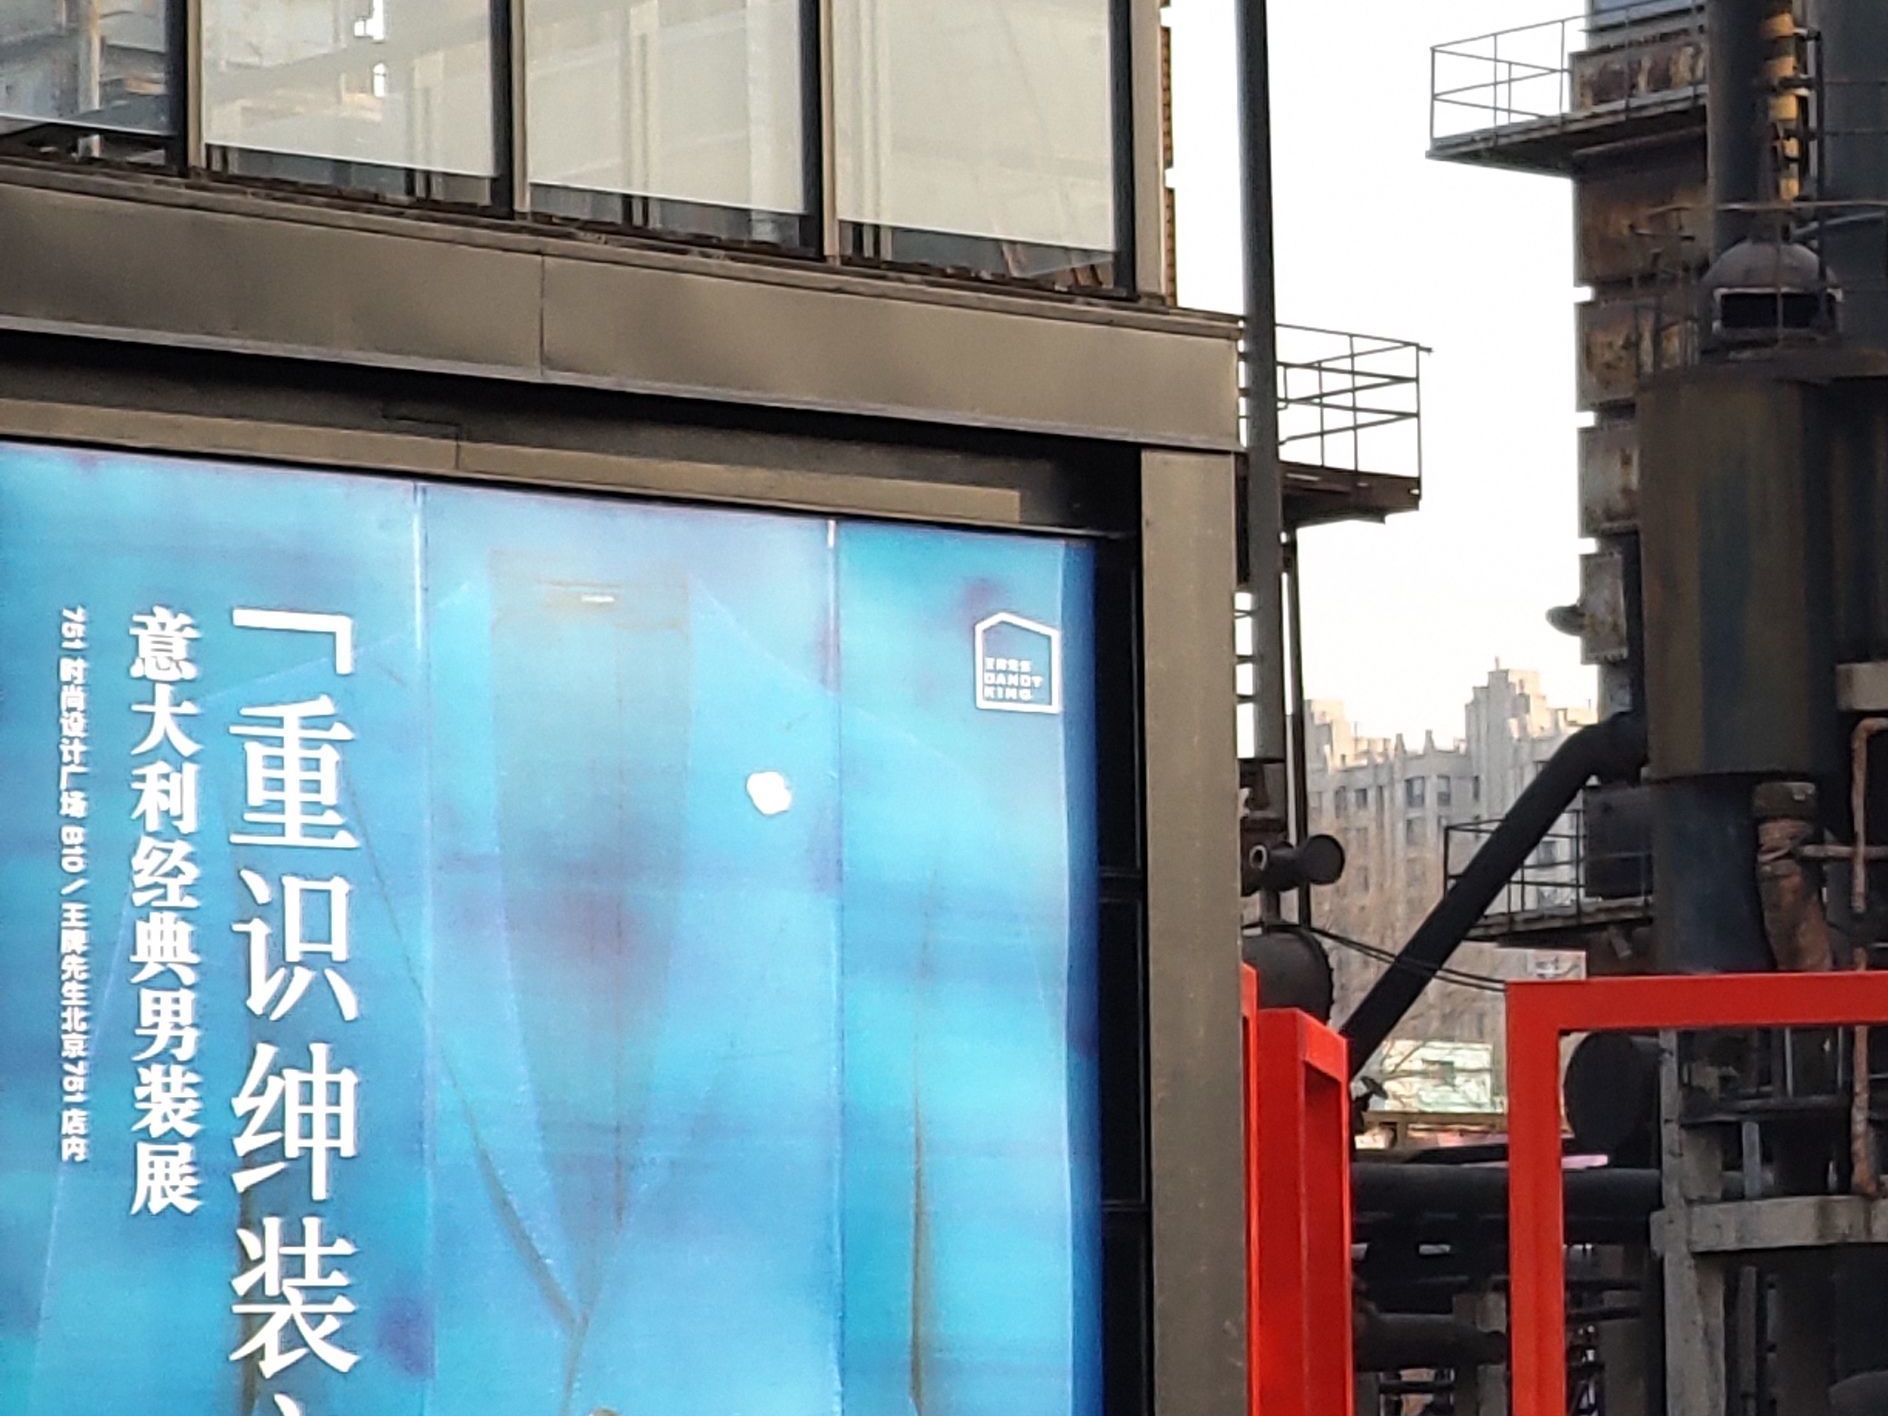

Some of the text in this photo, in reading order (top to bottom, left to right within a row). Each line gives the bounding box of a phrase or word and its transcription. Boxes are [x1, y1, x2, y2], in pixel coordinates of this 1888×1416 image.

[128, 605, 203, 1216] 意大利经典男装展
